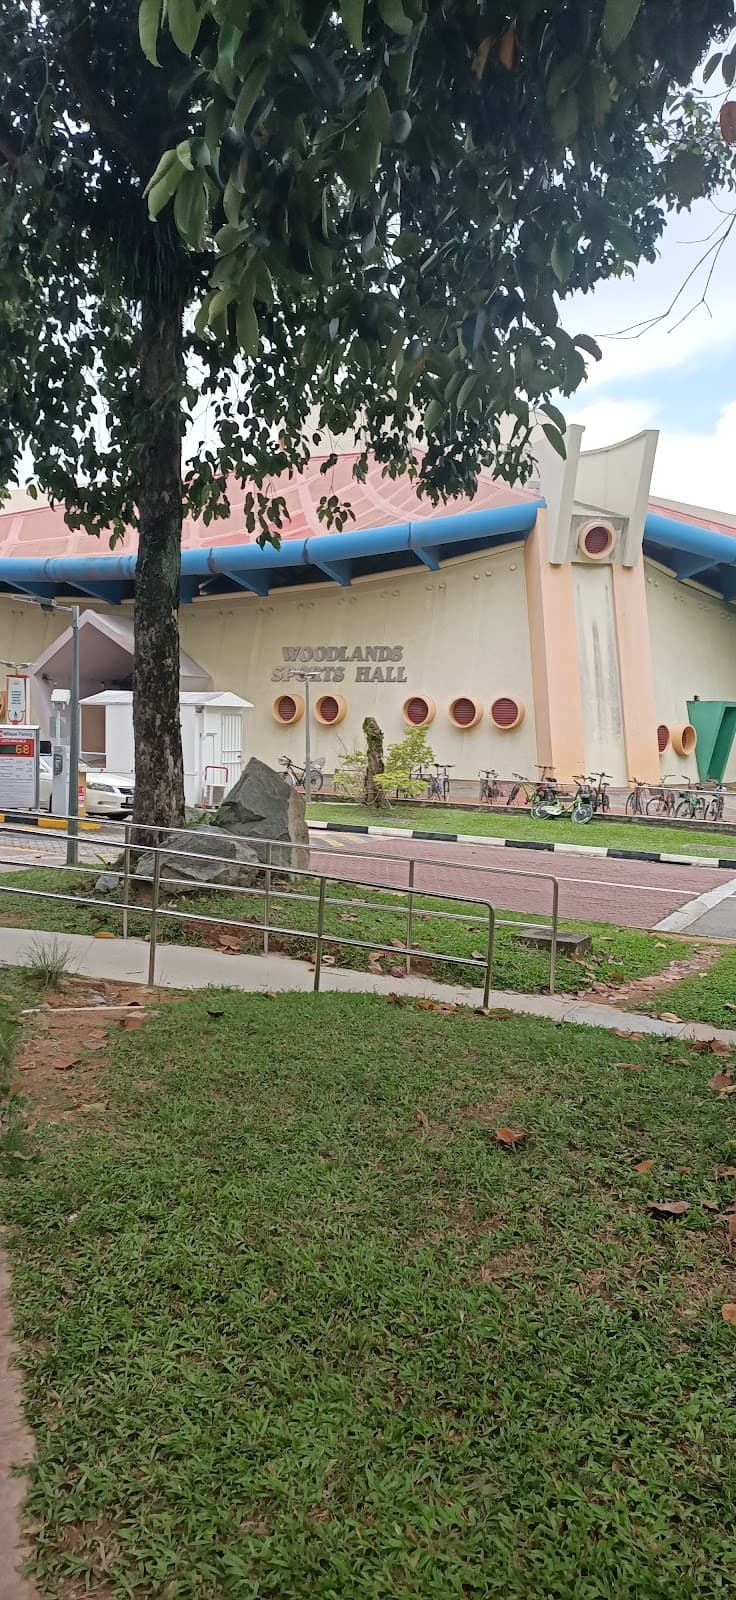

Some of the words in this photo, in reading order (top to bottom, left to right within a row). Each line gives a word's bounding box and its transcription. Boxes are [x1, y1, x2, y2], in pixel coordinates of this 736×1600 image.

[282, 645, 403, 662] WOODLANDS
[355, 666, 407, 682] HALL
[15, 744, 30, 754] 68
